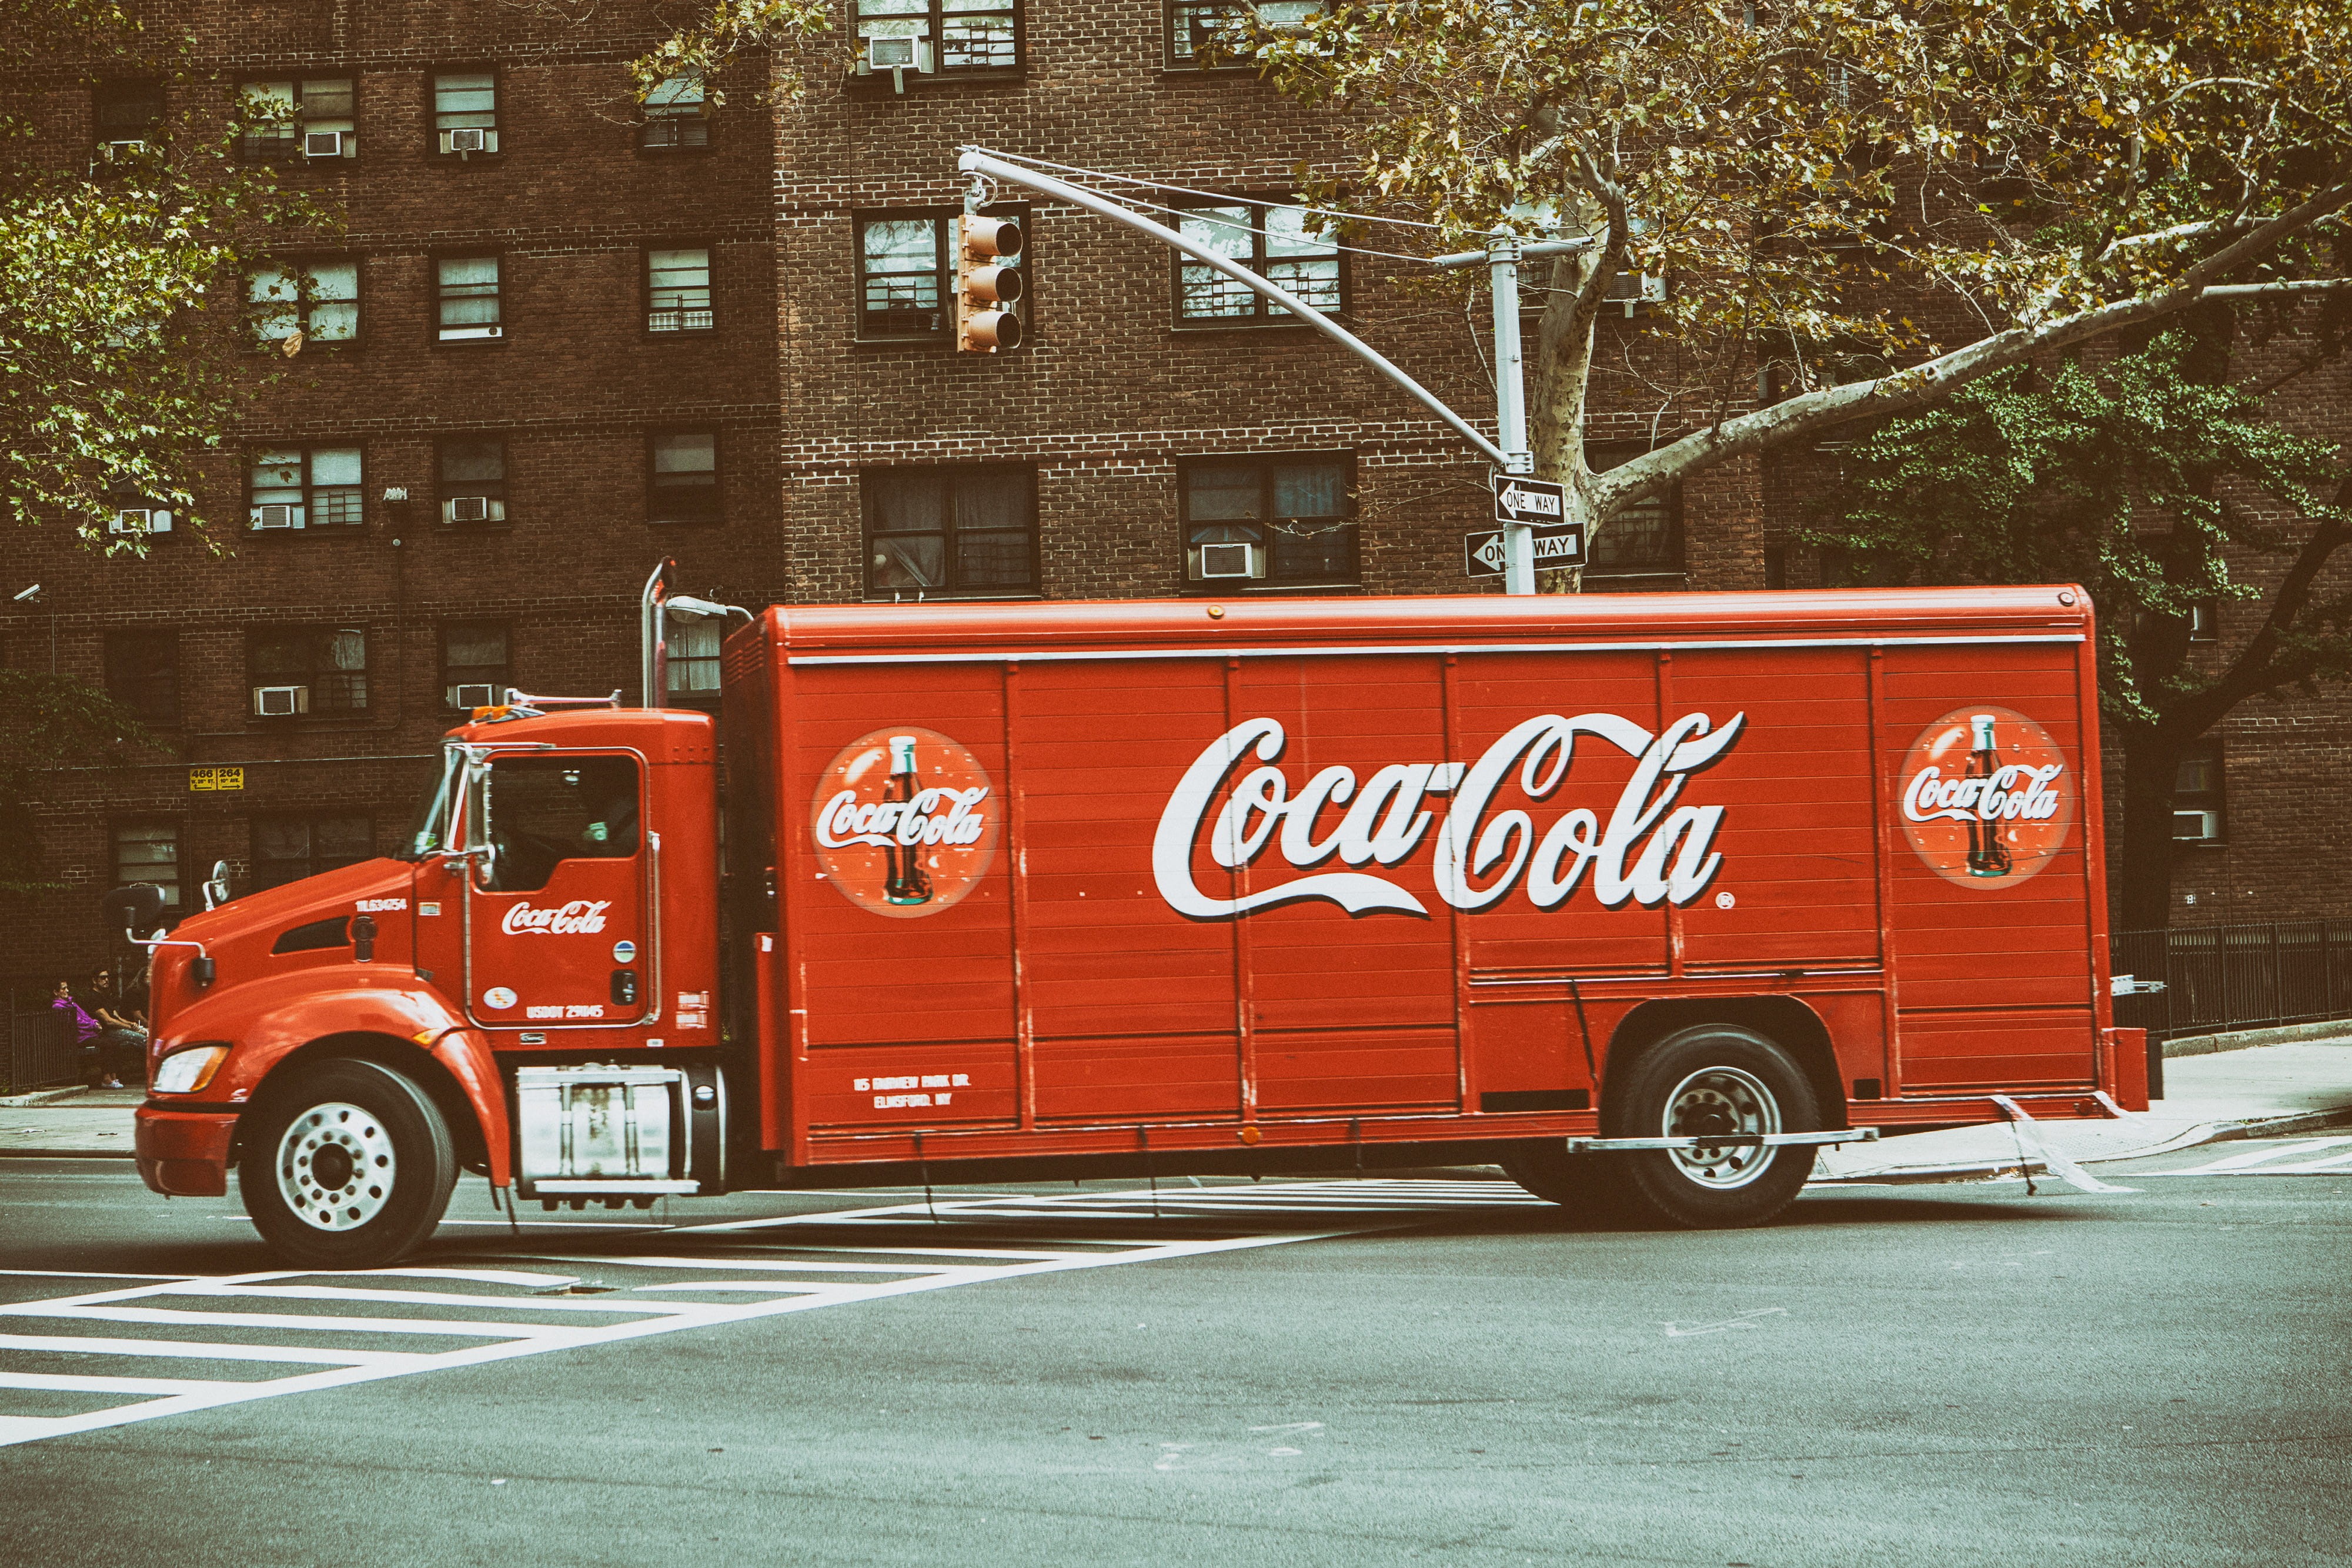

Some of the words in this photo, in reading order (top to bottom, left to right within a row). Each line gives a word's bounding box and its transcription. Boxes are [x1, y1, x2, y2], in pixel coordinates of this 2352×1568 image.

[1506, 492, 1526, 509] ONE
[1535, 495, 1555, 512] WAY
[1485, 544, 1505, 561] ON
[1534, 537, 1569, 556] WAY
[192, 769, 213, 778] 466
[219, 768, 240, 777] 264
[1903, 764, 2064, 822] Coca-Cola
[816, 787, 990, 850] Coca-Cola
[1152, 711, 1744, 917] Coca-Cola
[502, 900, 613, 935] Coca-Cola
